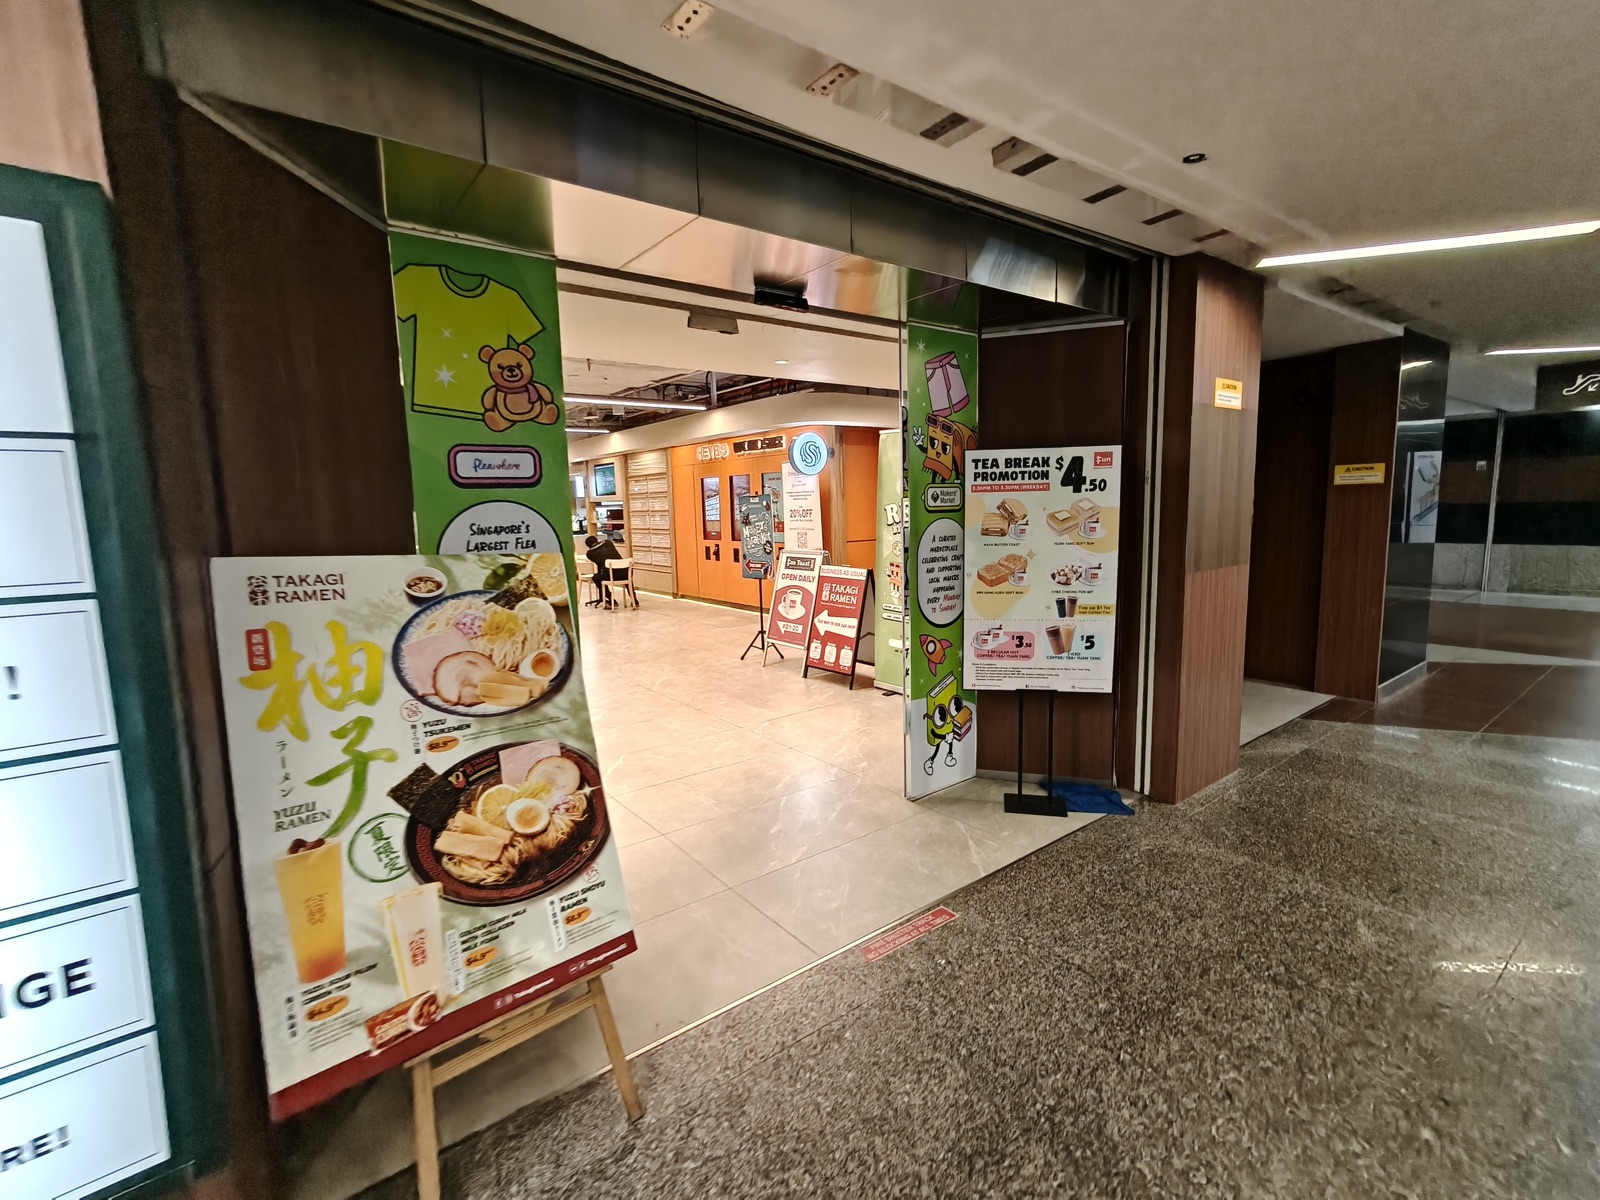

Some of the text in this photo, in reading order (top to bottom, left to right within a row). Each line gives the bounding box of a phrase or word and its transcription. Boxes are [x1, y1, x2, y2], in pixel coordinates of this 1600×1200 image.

[971, 456, 1051, 470] TEA BREAK
[973, 469, 1050, 482] PROMOTION
[931, 534, 957, 543] A CURATED
[466, 537, 537, 553] LARGEST FLEA
[930, 545, 959, 553] MARKETPLACE
[921, 555, 949, 564] CELEBRATING
[926, 563, 962, 574] AND SUPPORTING
[271, 573, 345, 588] TAKAGI
[781, 573, 817, 583] OPEN DAILY
[942, 574, 960, 582] MAKERS
[831, 583, 860, 594] TAKAGI
[932, 584, 956, 593] HAPPENING
[275, 588, 347, 604] RAMEN
[830, 593, 857, 605] RAMEN
[926, 596, 941, 604] EVERY
[422, 718, 447, 729] YUZU
[423, 722, 472, 738] TSUKEMEN
[273, 801, 317, 820] YUZU
[275, 810, 332, 832] RAMEN
[580, 880, 606, 895] SHOYU
[560, 896, 589, 912] RAMEN
[0, 958, 96, 1019] GE
